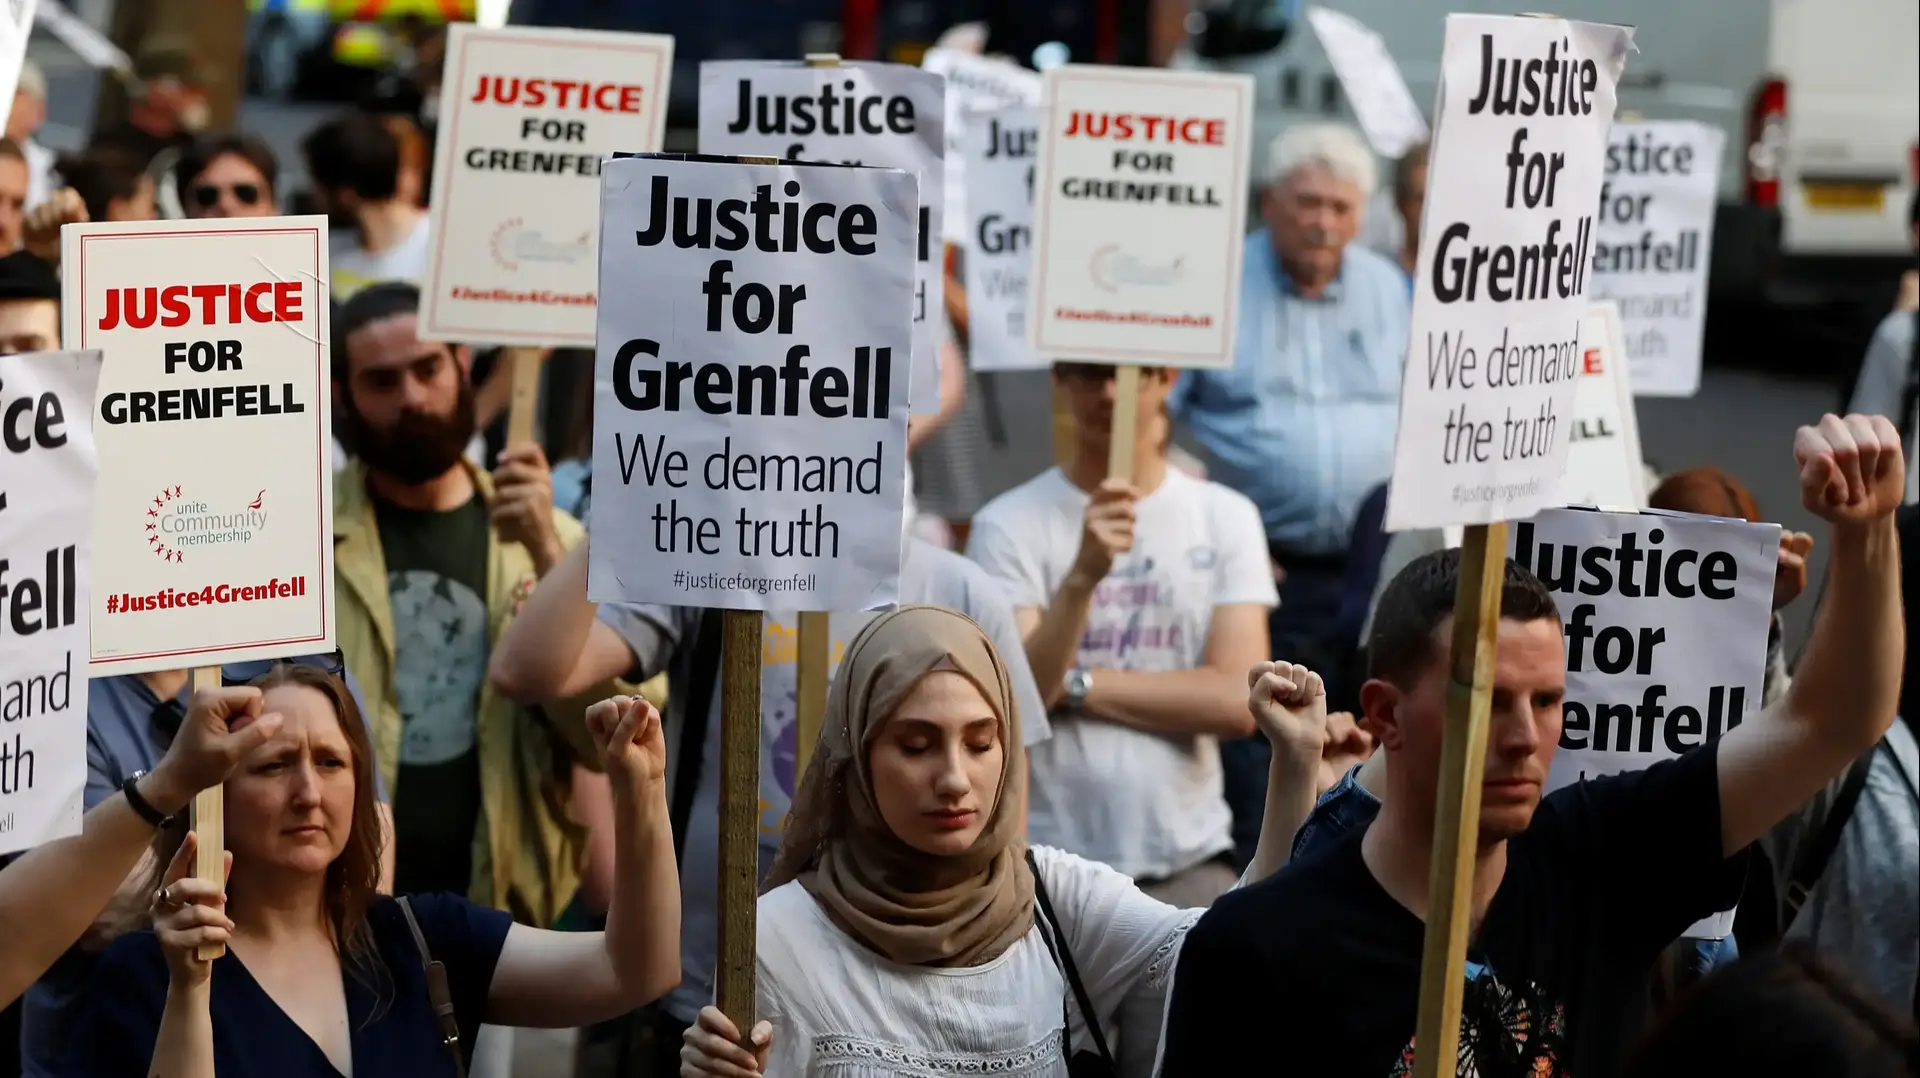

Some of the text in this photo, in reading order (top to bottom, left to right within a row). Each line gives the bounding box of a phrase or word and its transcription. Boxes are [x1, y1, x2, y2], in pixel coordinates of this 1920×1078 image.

[471, 75, 643, 113] JUSTICE
[1468, 34, 1598, 117] Justice
[521, 118, 586, 142] FOR
[727, 79, 916, 135] Justice
[1064, 111, 1225, 146] JUSTICE
[465, 147, 601, 176] GRENFE
[1111, 151, 1174, 174] FOR
[1506, 127, 1565, 209] for
[636, 175, 877, 256] Justice
[1061, 177, 1222, 207] GRENFELL
[1432, 216, 1592, 304] Grenfell
[98, 281, 303, 331] JUSTICE
[702, 259, 807, 334] for
[164, 340, 243, 374] FOR
[612, 338, 892, 420] Grenfell
[1428, 320, 1579, 391] We demand
[0, 377, 68, 454] ce
[100, 383, 304, 425] GRENFELL
[1443, 396, 1557, 465] the truth
[615, 432, 883, 495] We demand
[161, 509, 268, 534] Community
[177, 501, 208, 516] unite
[651, 498, 839, 558] the truth
[177, 527, 252, 546] membership
[106, 575, 306, 614] #Justice4Grenfell
[673, 571, 816, 595] #justiceforgrenfell
[1564, 604, 1666, 676] for
[0, 650, 71, 725] and
